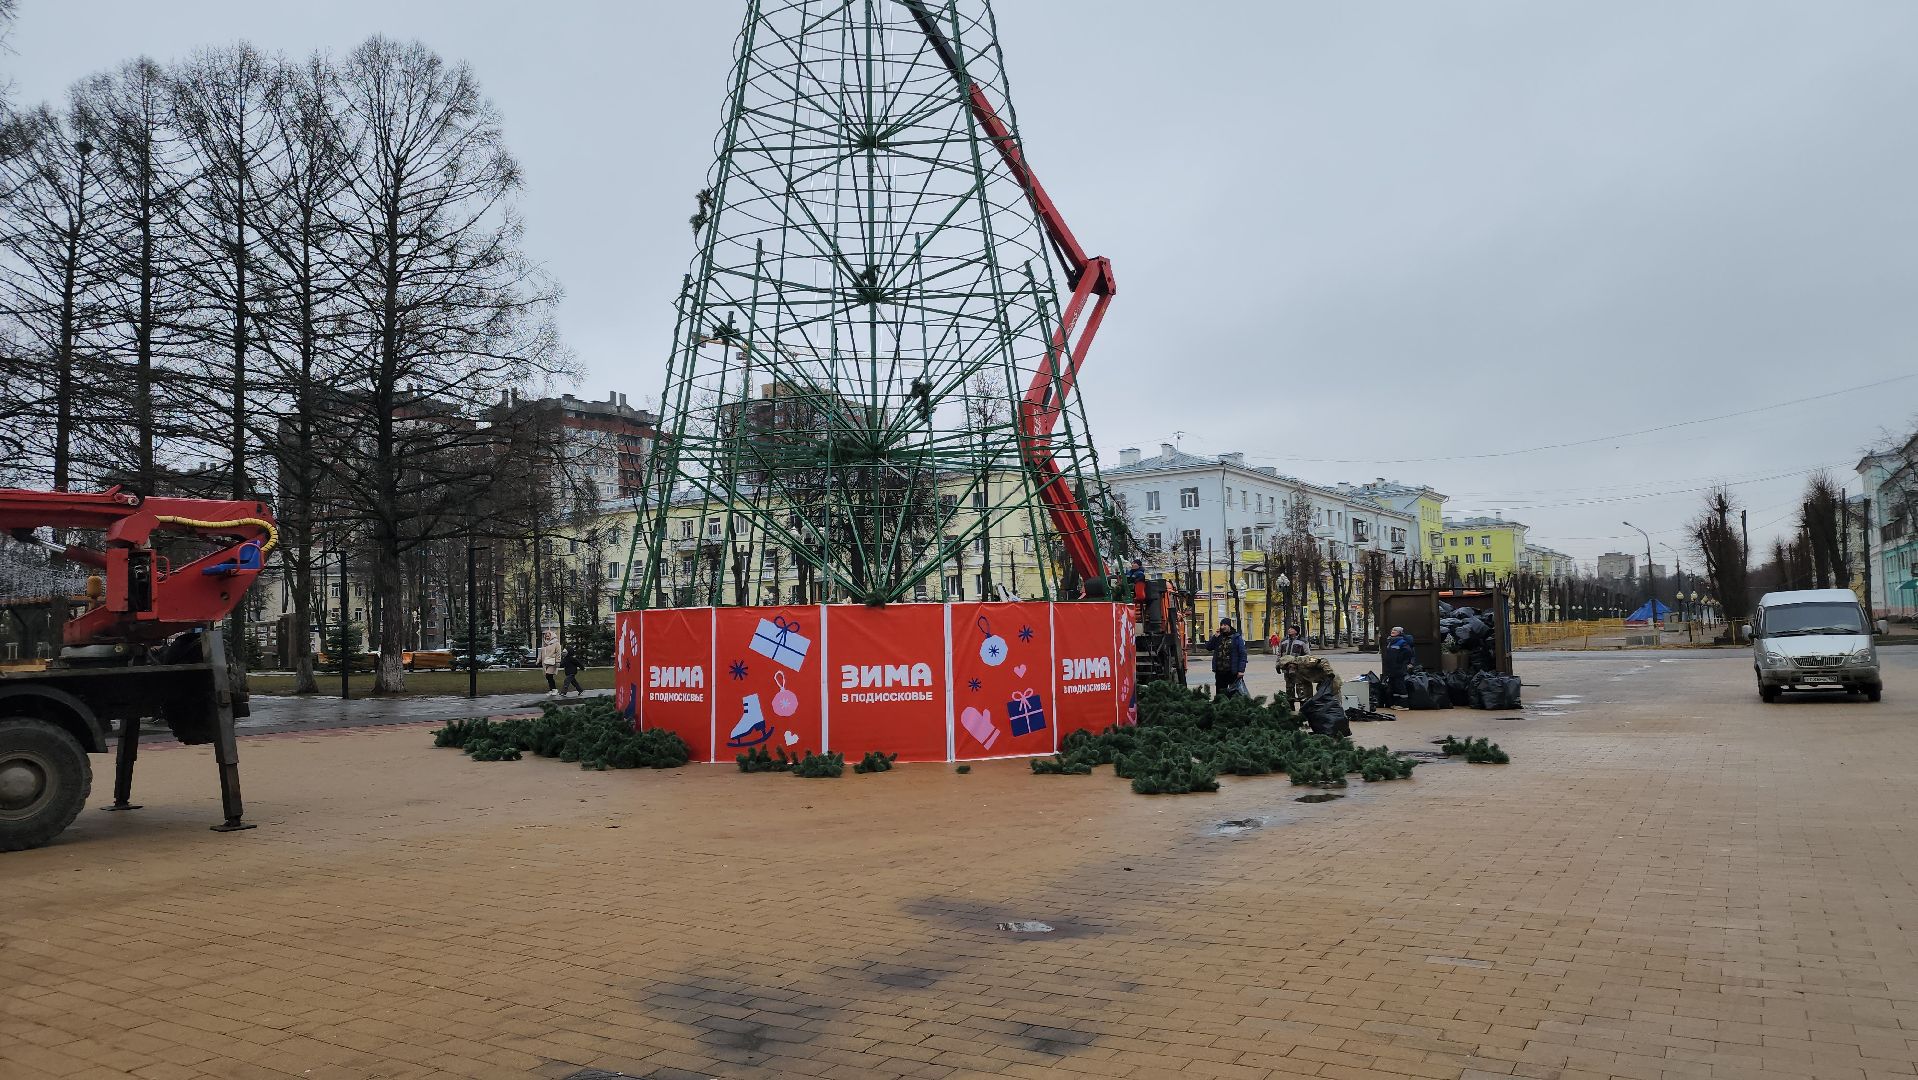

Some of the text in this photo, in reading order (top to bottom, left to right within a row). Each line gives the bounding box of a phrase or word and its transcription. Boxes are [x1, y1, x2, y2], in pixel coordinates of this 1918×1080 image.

[649, 665, 704, 689] ЗИМА
[841, 662, 933, 689] ЗИМА
[1062, 656, 1111, 681] ЗИМА
[655, 692, 704, 703] ПОДМОСКОВЬЕ
[841, 691, 933, 704] В ПОДМОСКОВЬЕ
